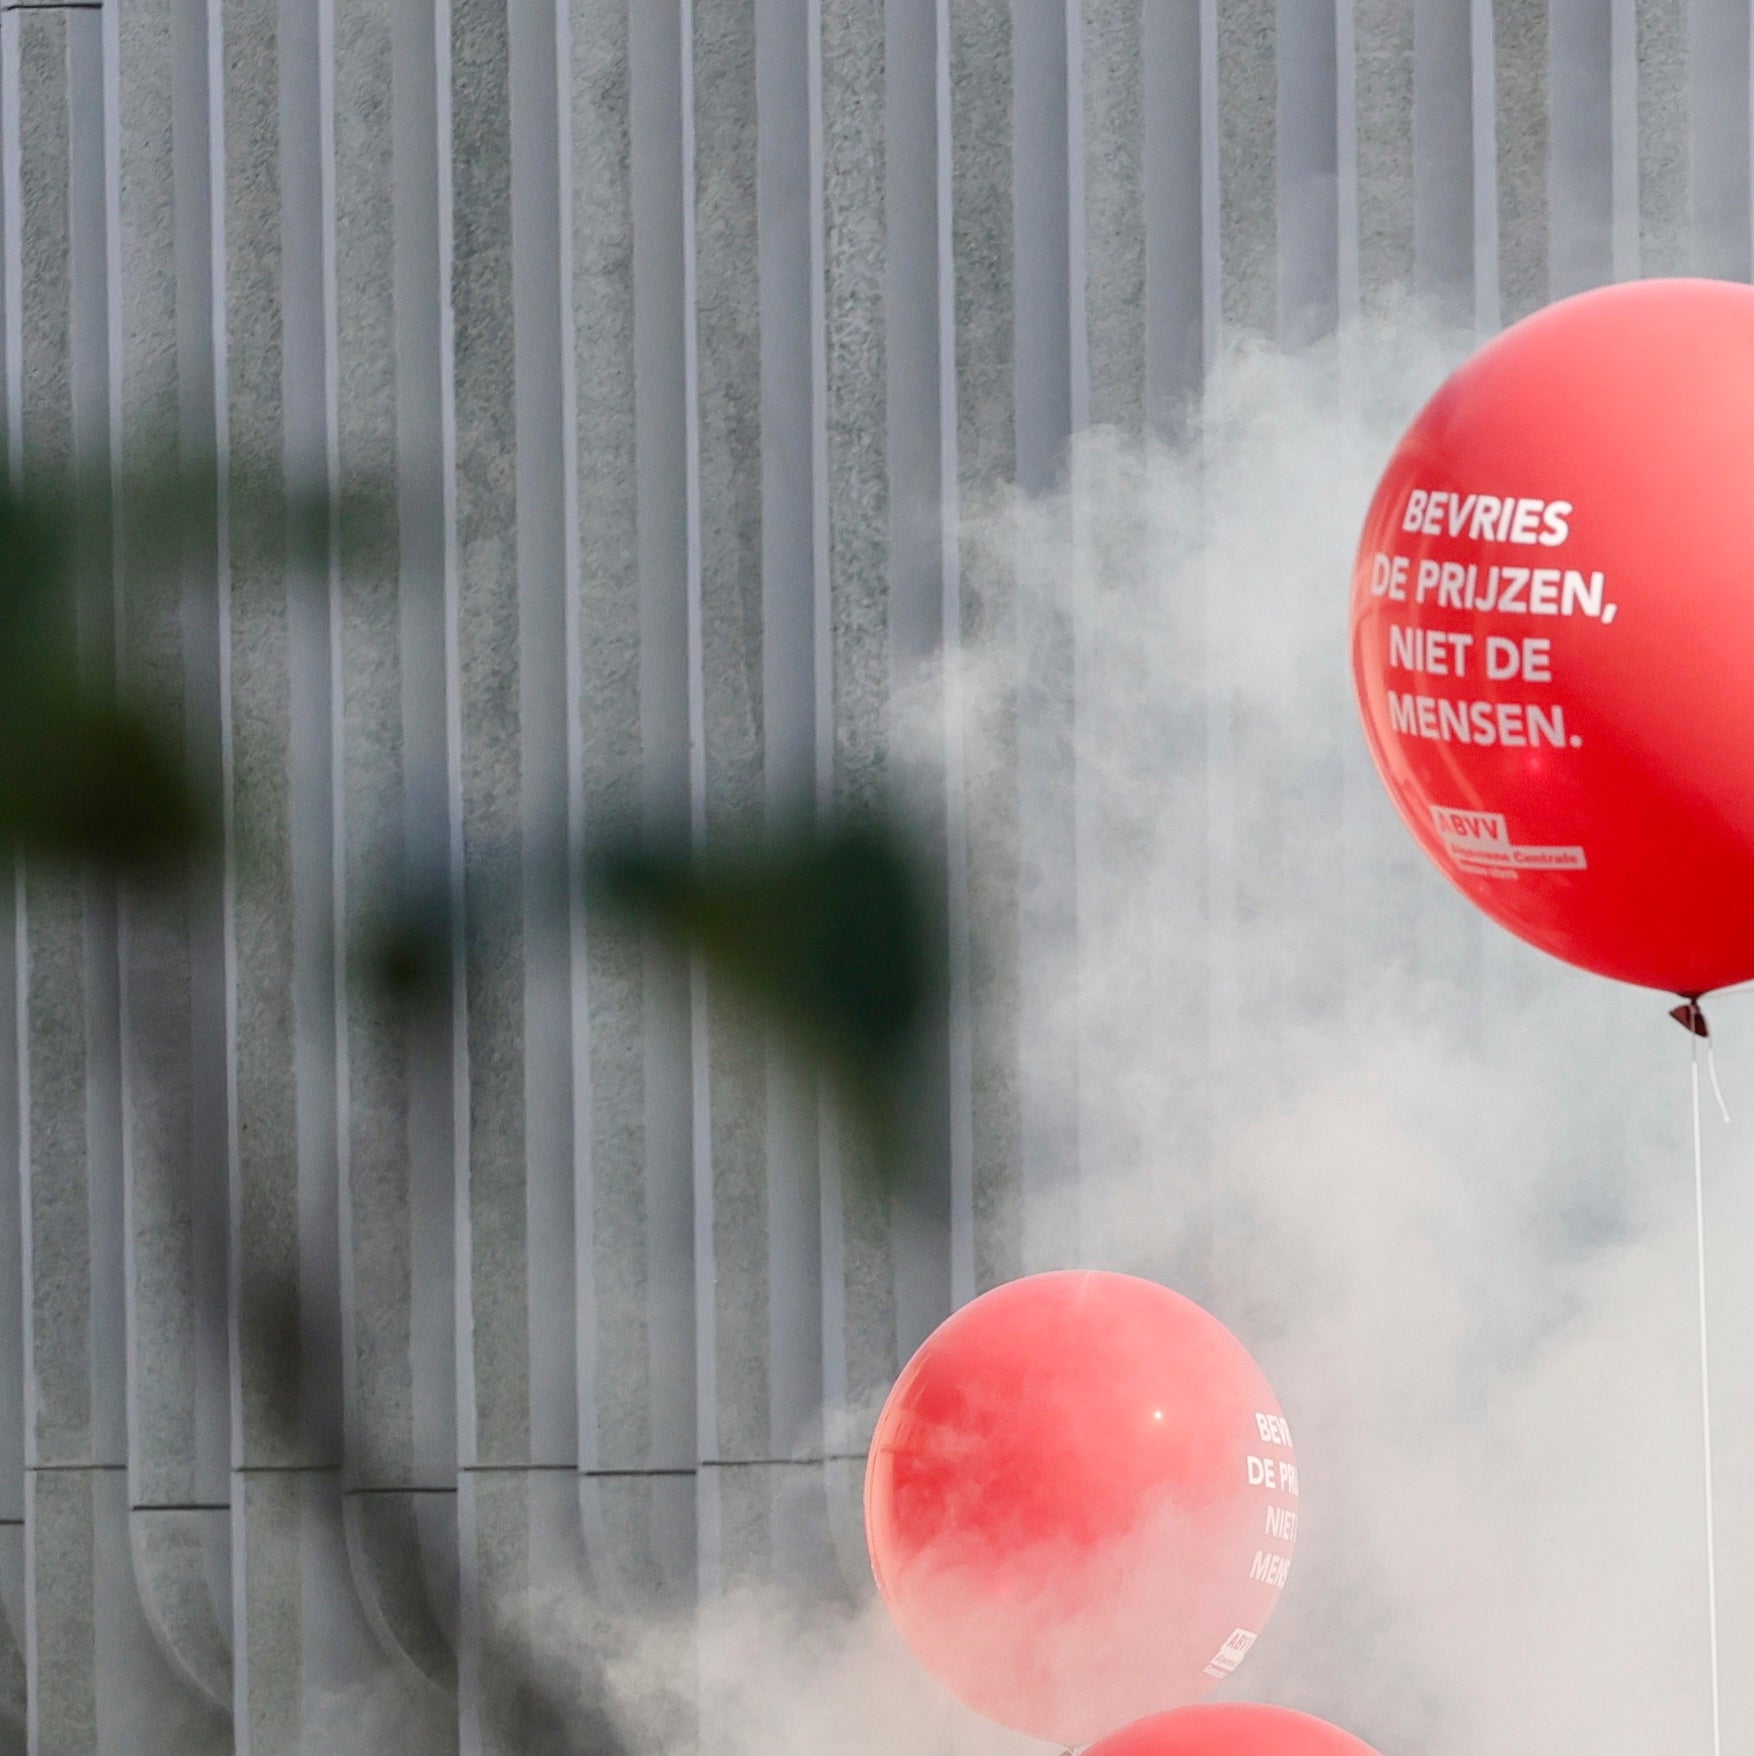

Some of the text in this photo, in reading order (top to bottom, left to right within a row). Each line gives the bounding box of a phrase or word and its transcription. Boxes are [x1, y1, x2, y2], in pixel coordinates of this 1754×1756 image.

[1402, 489, 1572, 546] BEVRIES
[1371, 553, 1618, 624] DE PRIJZEN,
[1388, 625, 1552, 682] NIET DE
[1386, 690, 1583, 748] MENSEN.
[1246, 1455, 1277, 1489] DE
